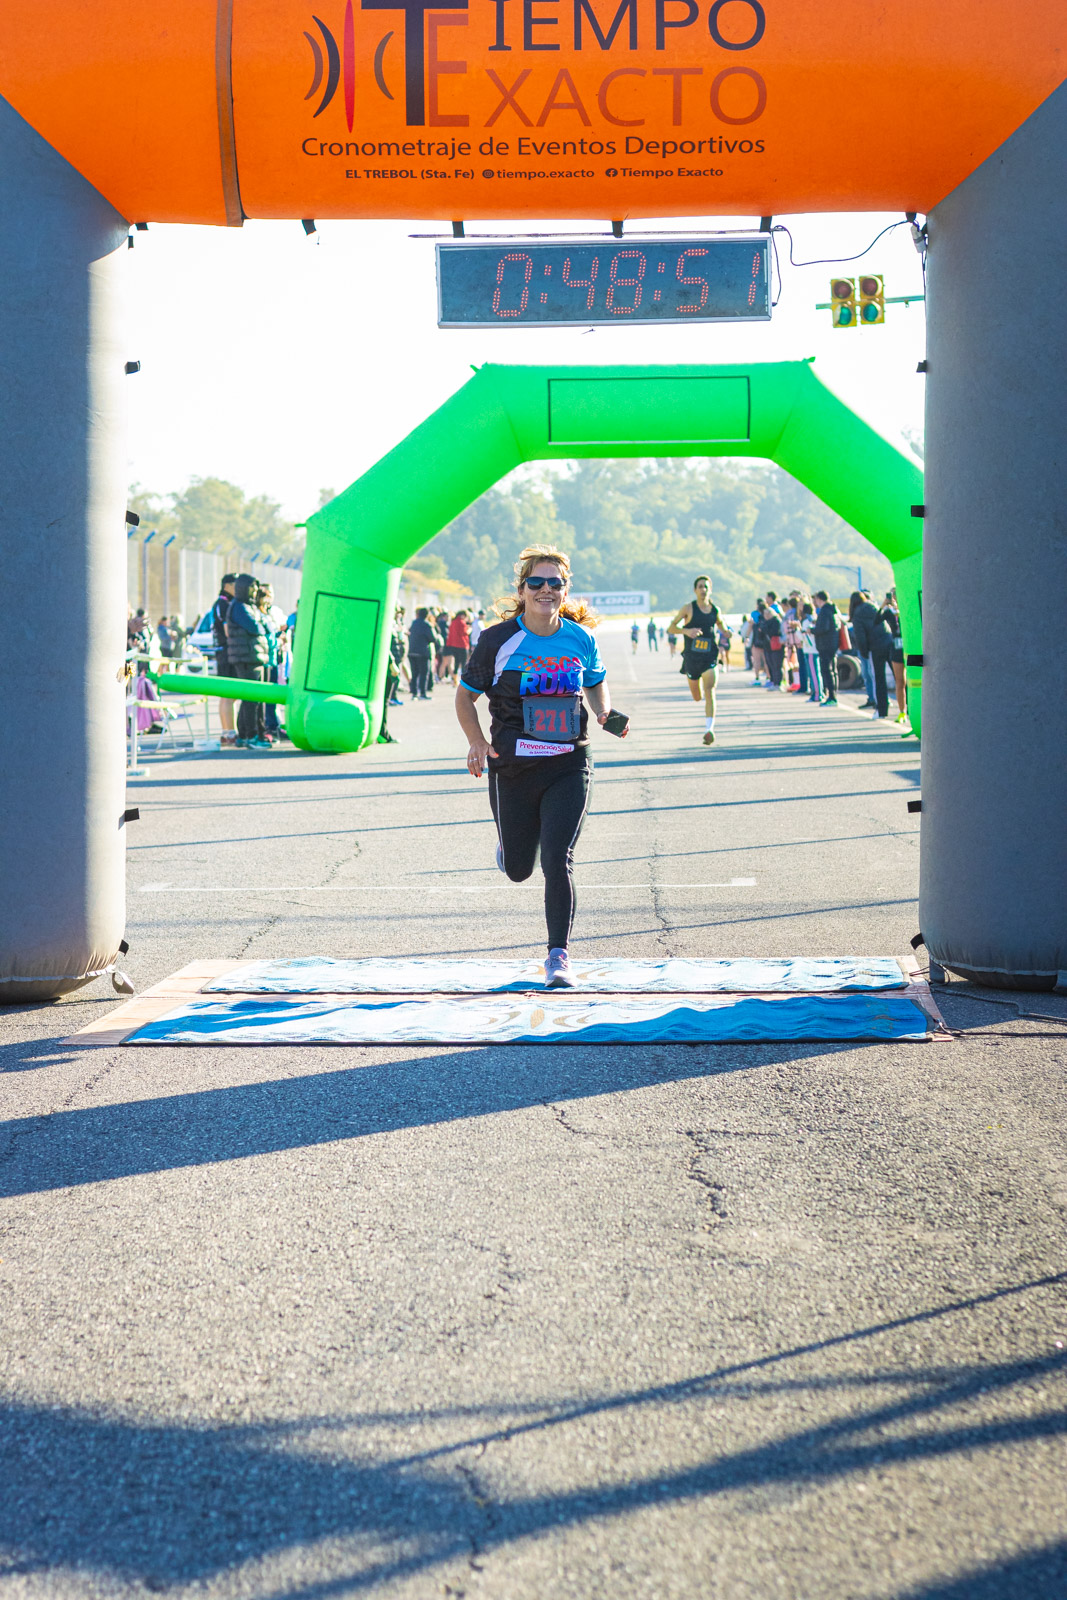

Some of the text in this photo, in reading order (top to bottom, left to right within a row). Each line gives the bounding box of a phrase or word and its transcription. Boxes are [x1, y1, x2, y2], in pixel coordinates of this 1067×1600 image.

[301, 136, 766, 161] Cronometraje de Eventos Deportivos
[345, 167, 724, 181] EL TREBOL (Sta. Fe) tiempo.exacto Tiempo Exacto
[520, 672, 580, 695] RUN
[534, 709, 568, 733] 271
